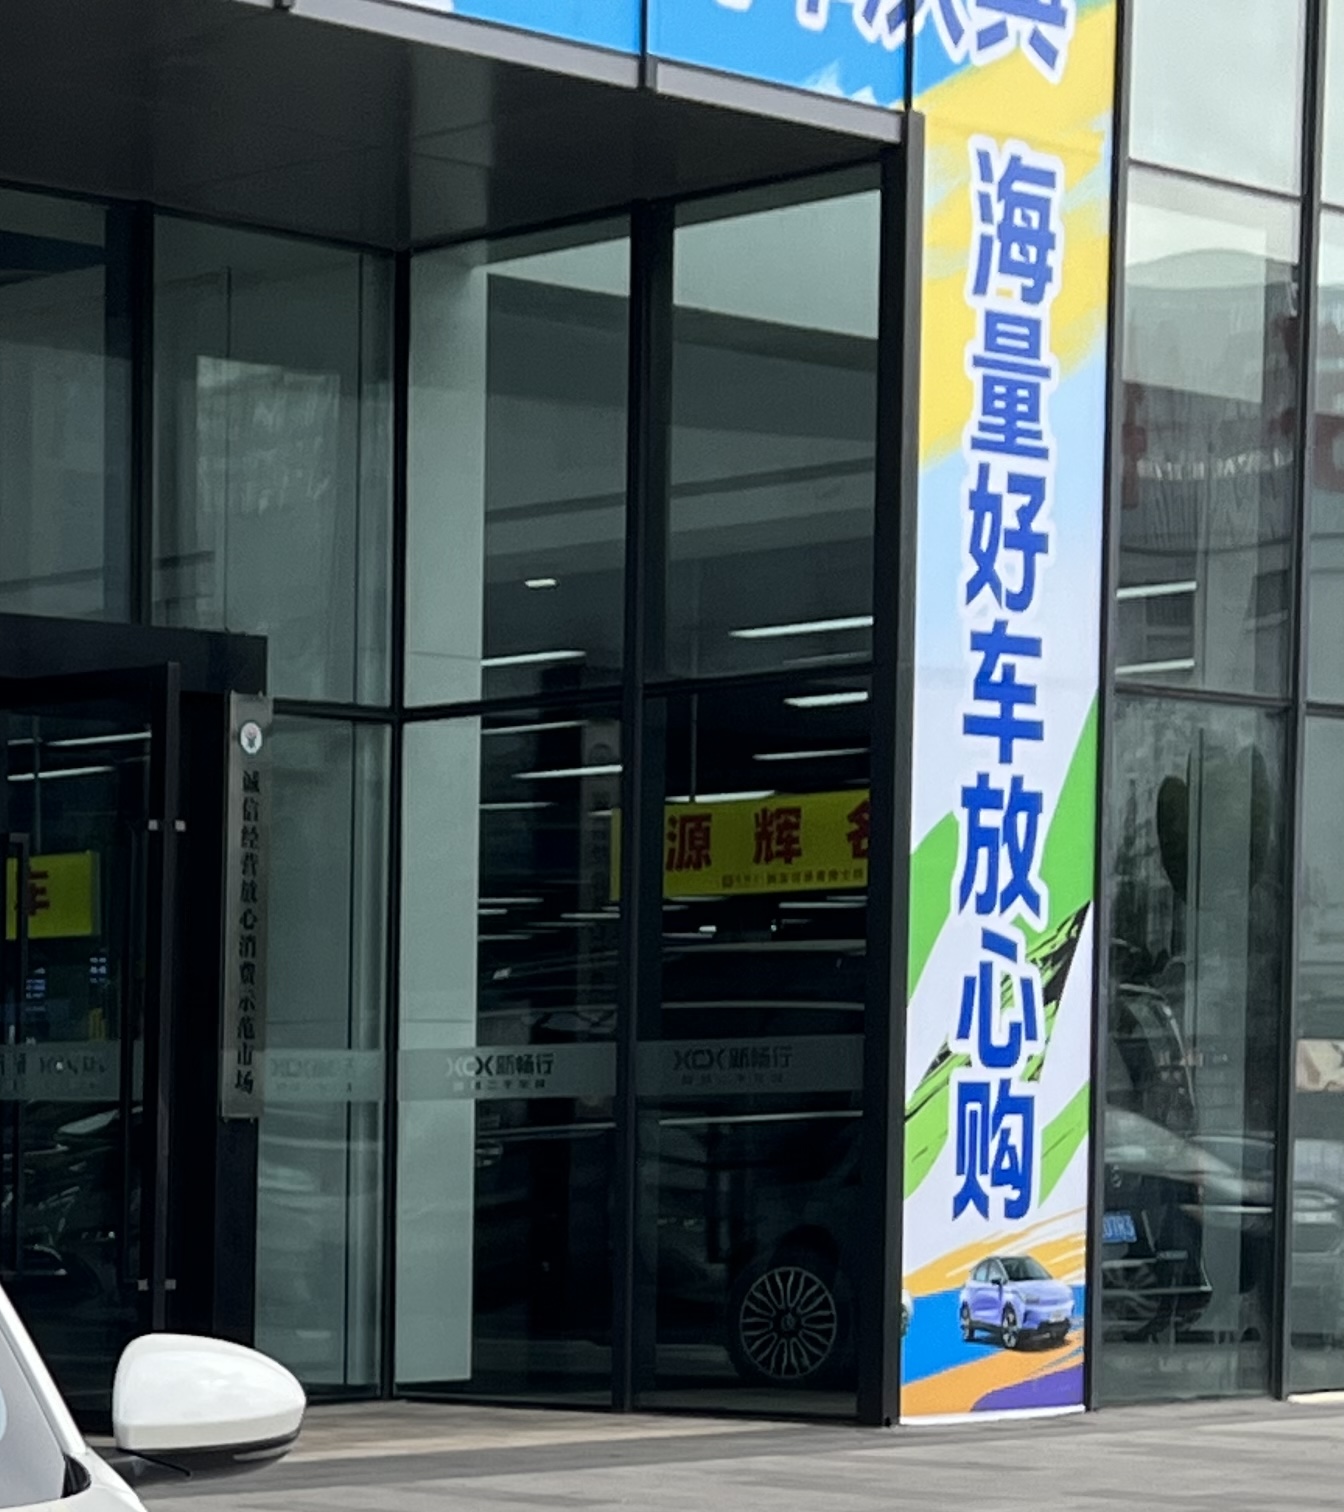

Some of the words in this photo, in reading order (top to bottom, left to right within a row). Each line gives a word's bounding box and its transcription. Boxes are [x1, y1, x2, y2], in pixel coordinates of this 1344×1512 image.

[953, 148, 1058, 1219] 海量好车放心购
